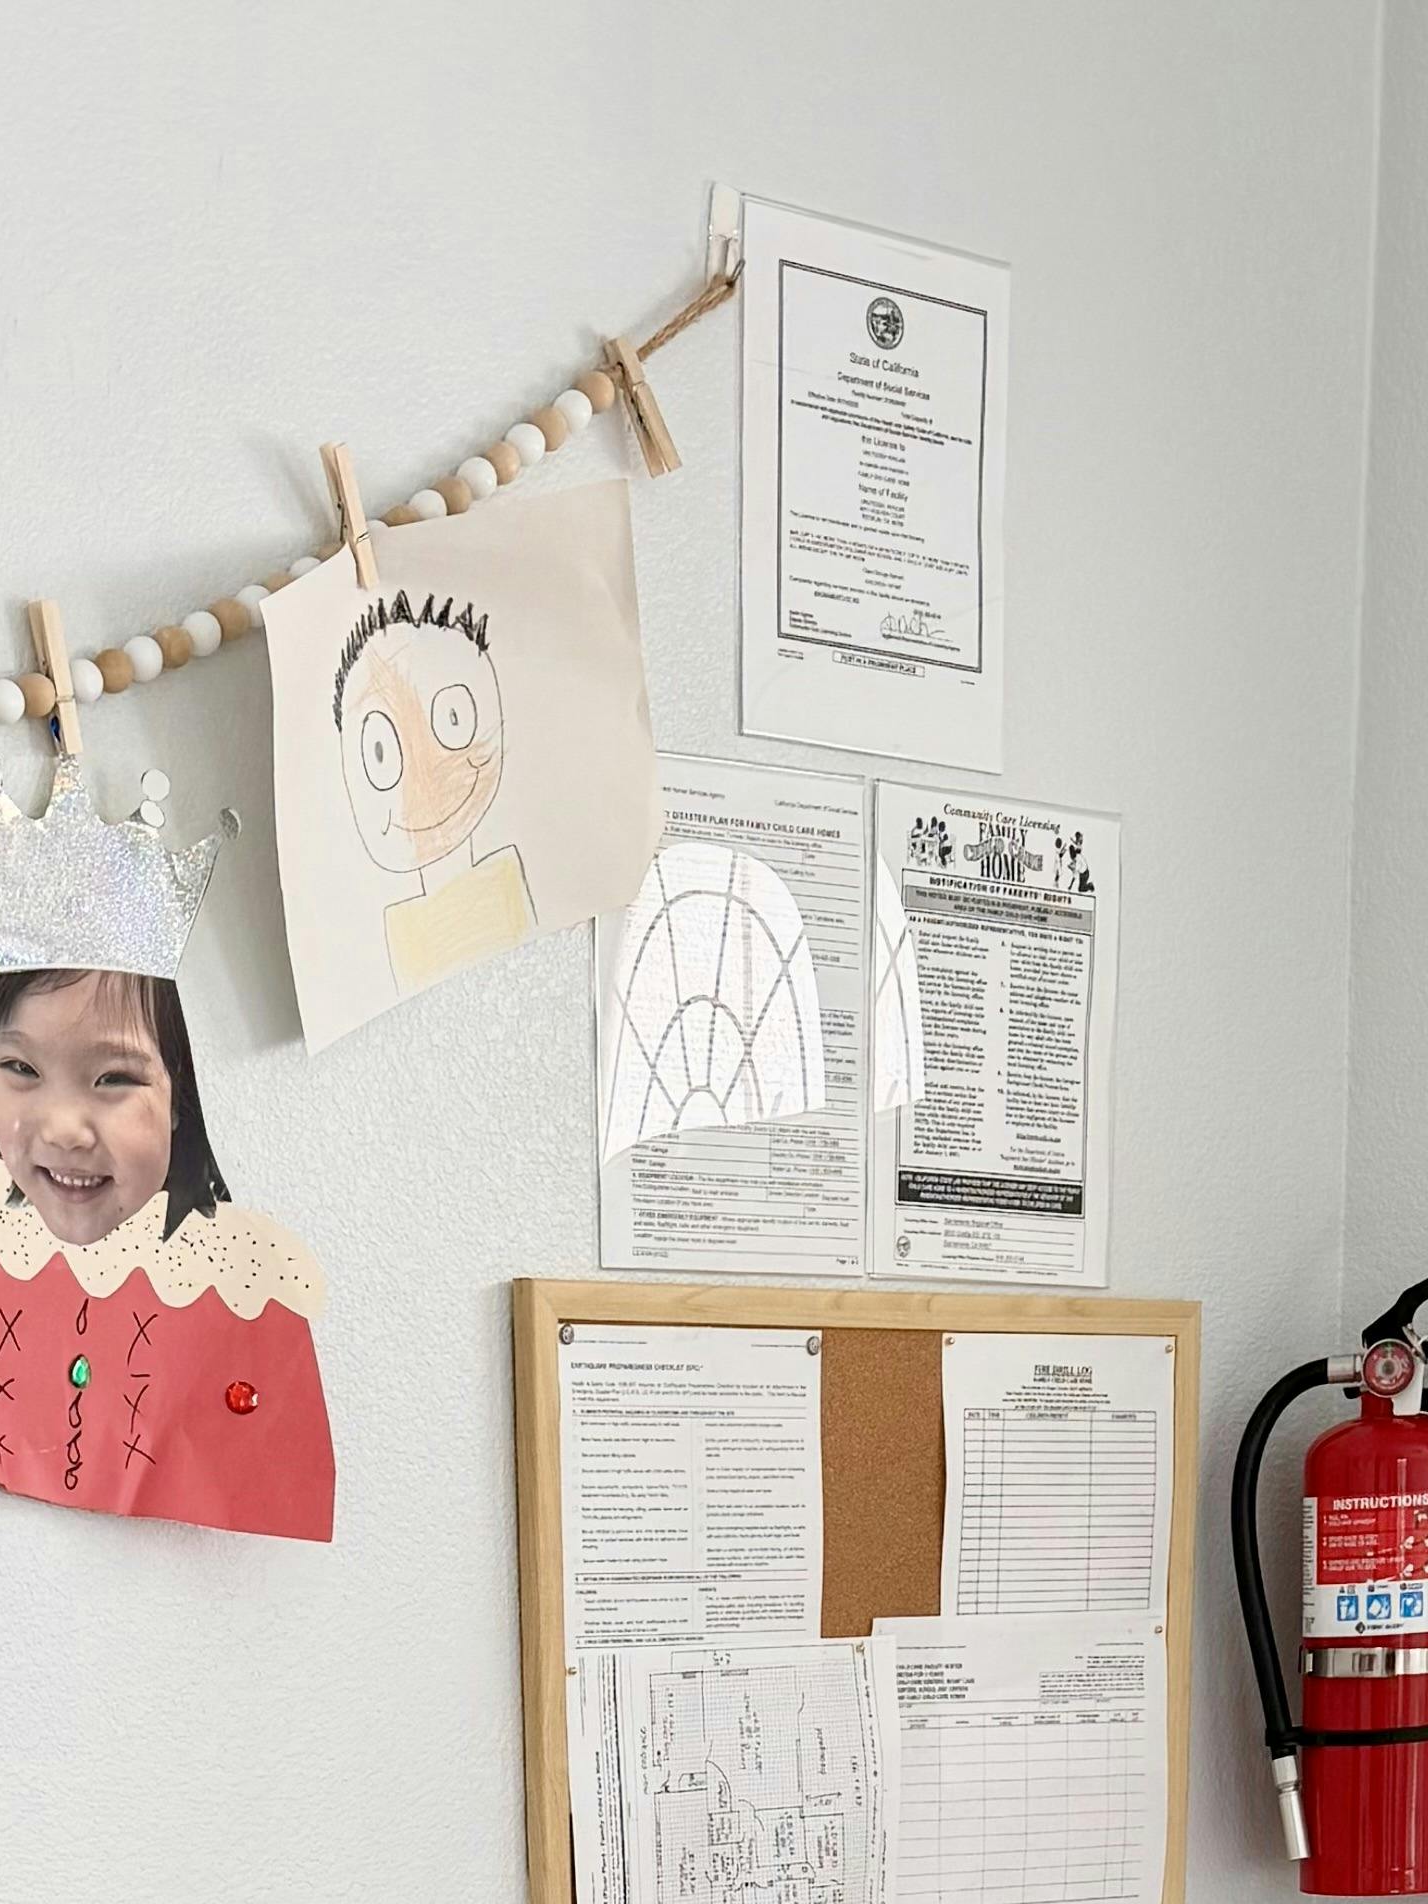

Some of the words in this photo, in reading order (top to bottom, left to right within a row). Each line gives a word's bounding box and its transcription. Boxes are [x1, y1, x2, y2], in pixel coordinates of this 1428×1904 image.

[849, 352, 870, 367] State
[882, 359, 919, 378] California
[672, 810, 708, 824] DISASTER
[709, 815, 729, 826] PLAN
[730, 817, 745, 828] FOR
[746, 818, 772, 831] FAMILY
[772, 823, 795, 834] CHILD
[796, 825, 816, 836] CARE
[817, 828, 842, 839] HOMES
[943, 803, 994, 823] Community
[996, 811, 1017, 825] Care
[1019, 814, 1061, 835] Licensing
[978, 822, 1028, 848] FAMILY
[980, 853, 1026, 884] HOME
[929, 876, 987, 893] NOTIFICATION
[988, 884, 1000, 894] OF
[1002, 887, 1040, 901] PARENTS'
[1043, 893, 1072, 905] RIGHTS
[1034, 1364, 1051, 1375] FIRE
[1052, 1364, 1075, 1377] DRILL
[1076, 1366, 1093, 1379] LOG
